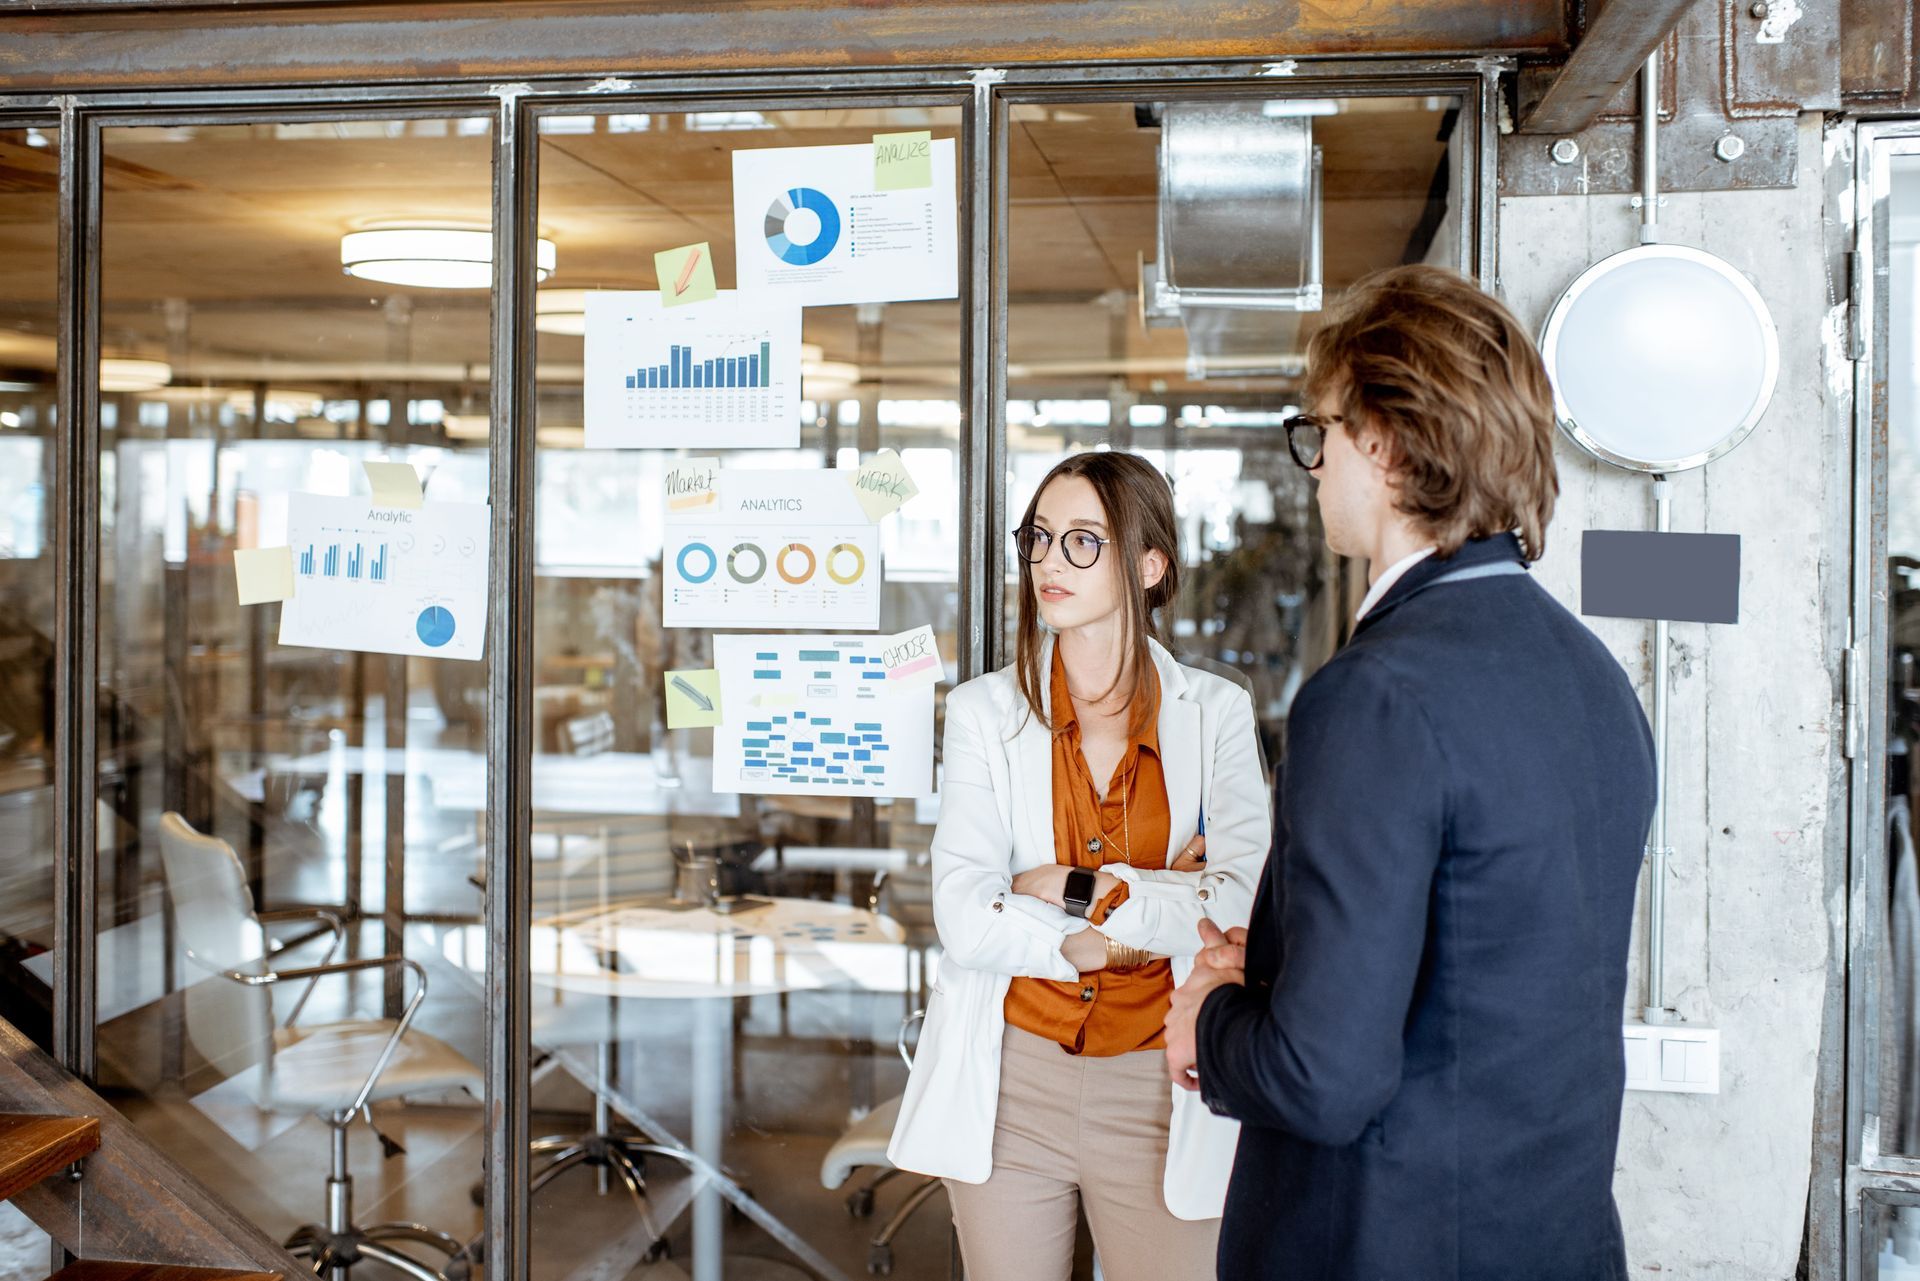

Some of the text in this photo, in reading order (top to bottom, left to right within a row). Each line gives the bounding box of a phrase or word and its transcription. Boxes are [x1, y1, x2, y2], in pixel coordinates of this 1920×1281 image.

[665, 467, 717, 496] Market
[856, 469, 905, 501] WORK
[740, 498, 802, 511] ANALYTICS
[367, 509, 412, 524] Analytic
